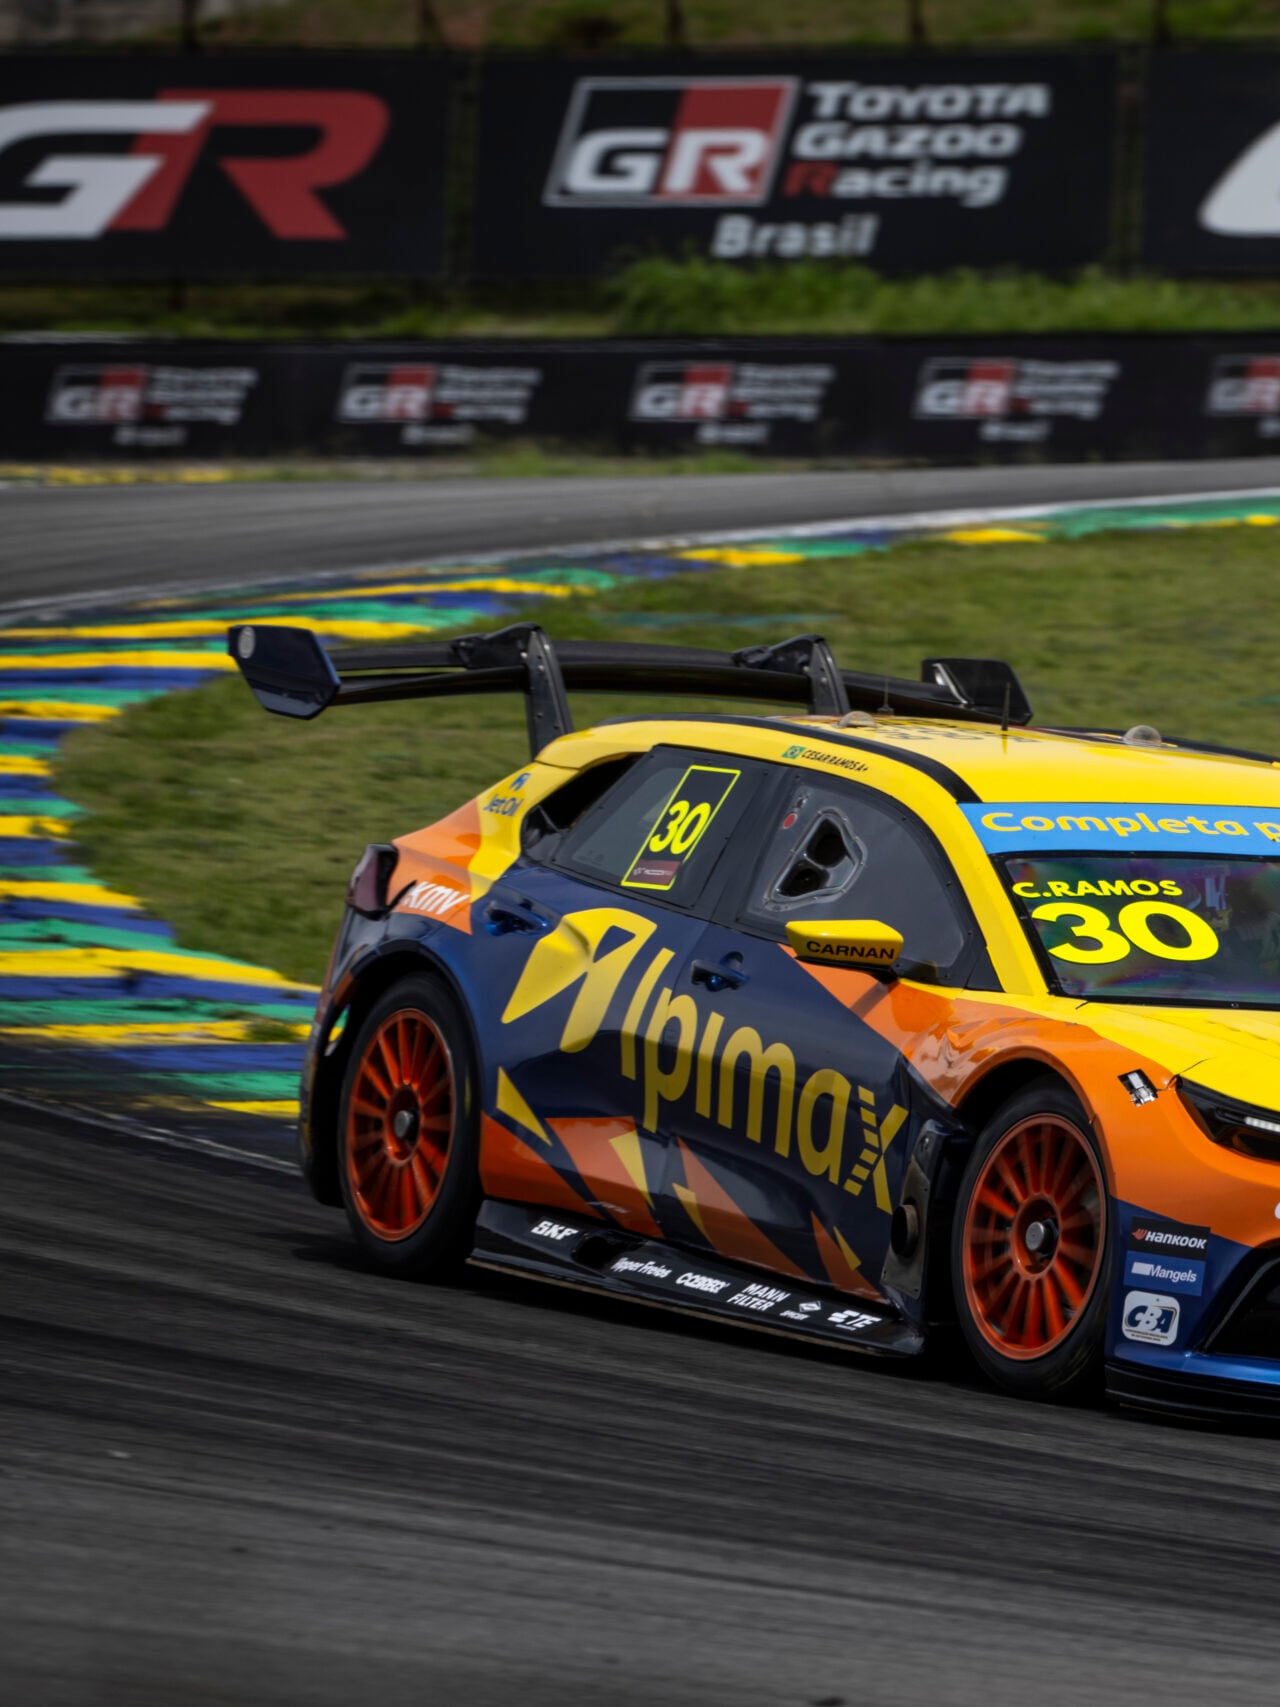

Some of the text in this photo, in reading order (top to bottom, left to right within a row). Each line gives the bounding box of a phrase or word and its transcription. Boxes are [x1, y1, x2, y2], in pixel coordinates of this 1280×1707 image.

[809, 83, 1050, 118] TOYOTA
[794, 122, 1022, 158] GAZOO
[565, 129, 769, 193] GR
[785, 160, 1008, 207] Racing
[713, 215, 879, 257] Brasil
[649, 800, 711, 855] 30
[981, 812, 1250, 837] Completa
[1012, 879, 1183, 898] C.RAMOS
[1032, 901, 1219, 965] 30
[805, 940, 895, 960] CARNAN
[620, 948, 909, 1215] Ipimax
[531, 1221, 579, 1241] SKF
[1149, 1264, 1198, 1284] Mangels
[726, 1293, 776, 1312] FILTER
[741, 1283, 791, 1303] MANN
[1127, 1305, 1174, 1334] CBA
